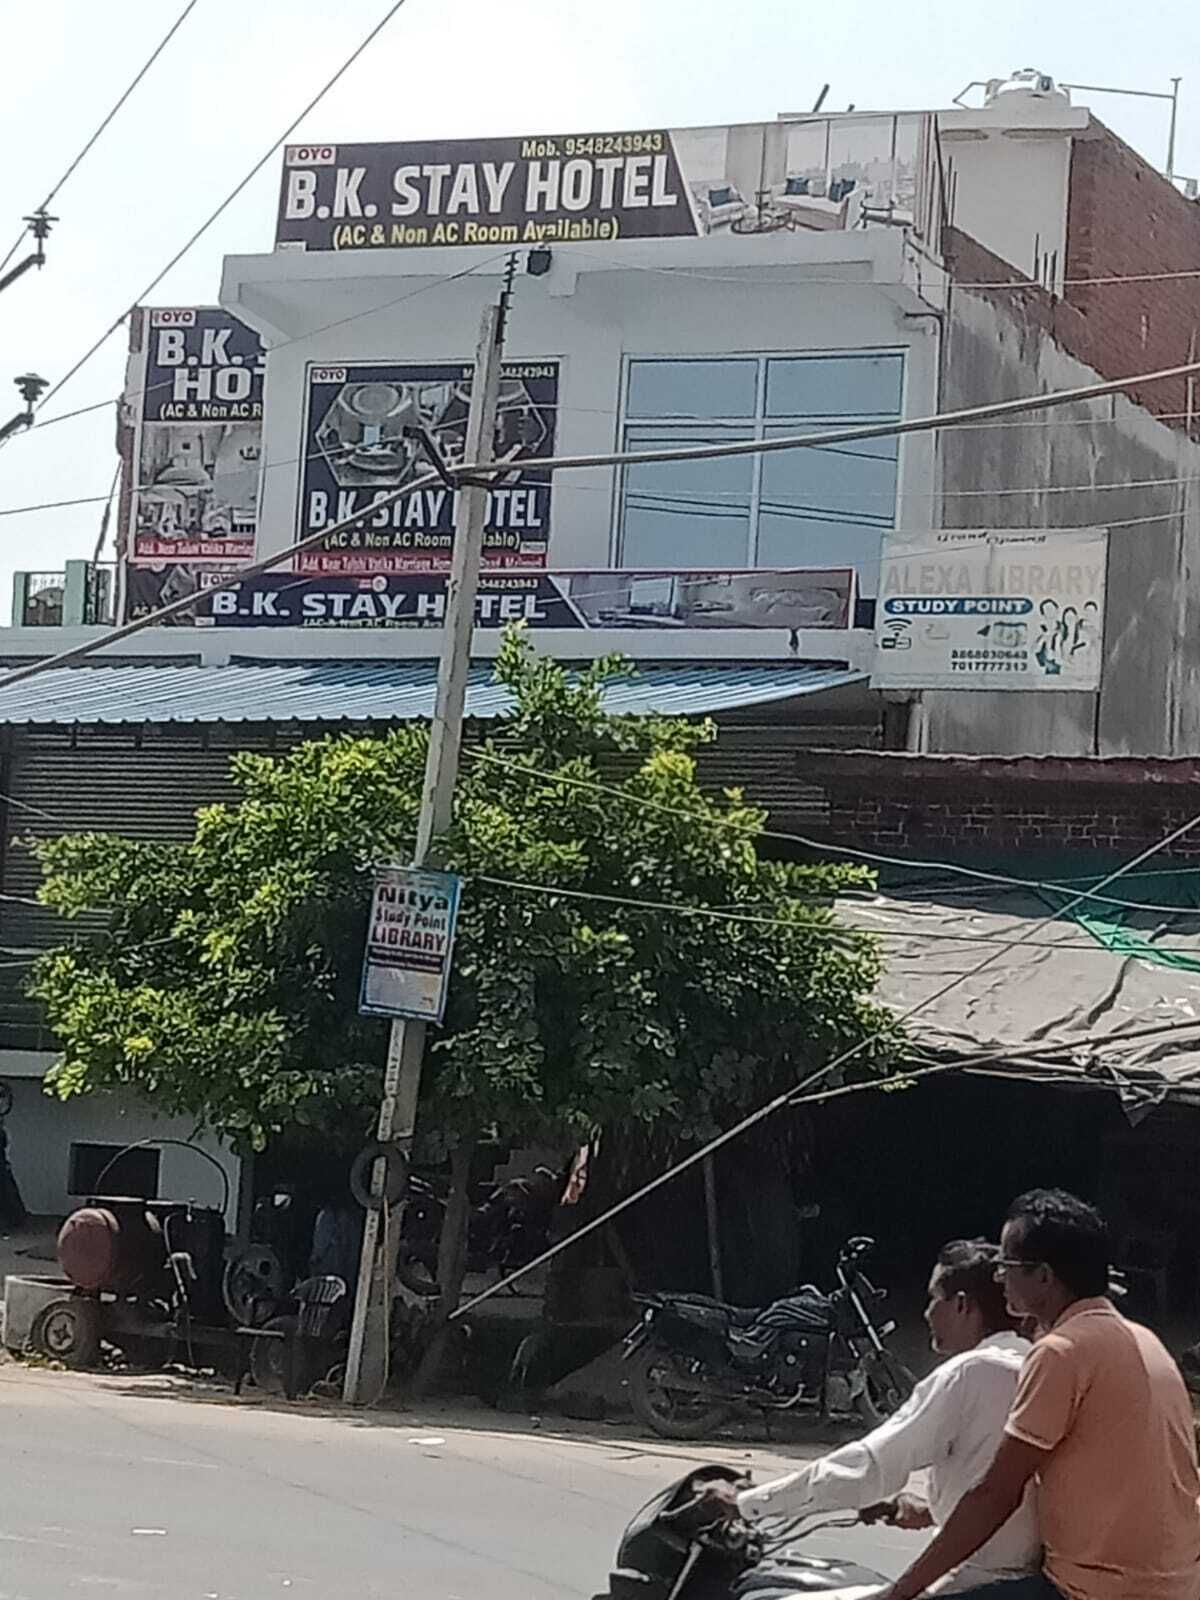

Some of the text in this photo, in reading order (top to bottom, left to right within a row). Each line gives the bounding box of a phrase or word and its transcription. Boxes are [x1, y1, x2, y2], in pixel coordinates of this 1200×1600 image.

[299, 148, 333, 161] OYO
[522, 134, 662, 157] Mob. 9548243943
[285, 155, 678, 220] B.K. STAY HOTEL
[333, 215, 619, 250] (AC & Non AC Room Available)
[162, 311, 193, 323] OYO
[157, 329, 243, 366] B.K.
[160, 403, 185, 420] (AC
[188, 404, 198, 417] &
[202, 403, 227, 417] Non
[231, 403, 249, 416] AC
[372, 489, 446, 528] STAY
[351, 533, 360, 547] &
[364, 533, 390, 547] Non
[393, 533, 411, 546] AC
[414, 532, 451, 547] Room
[882, 563, 1100, 596] ALEXA LIBRARY
[212, 591, 546, 618] B.K. STAY HTEL
[892, 600, 1026, 613] STUDY POINT
[378, 886, 449, 911] Nitya
[375, 907, 446, 932] Study Point
[371, 926, 446, 952] LIBRARY
